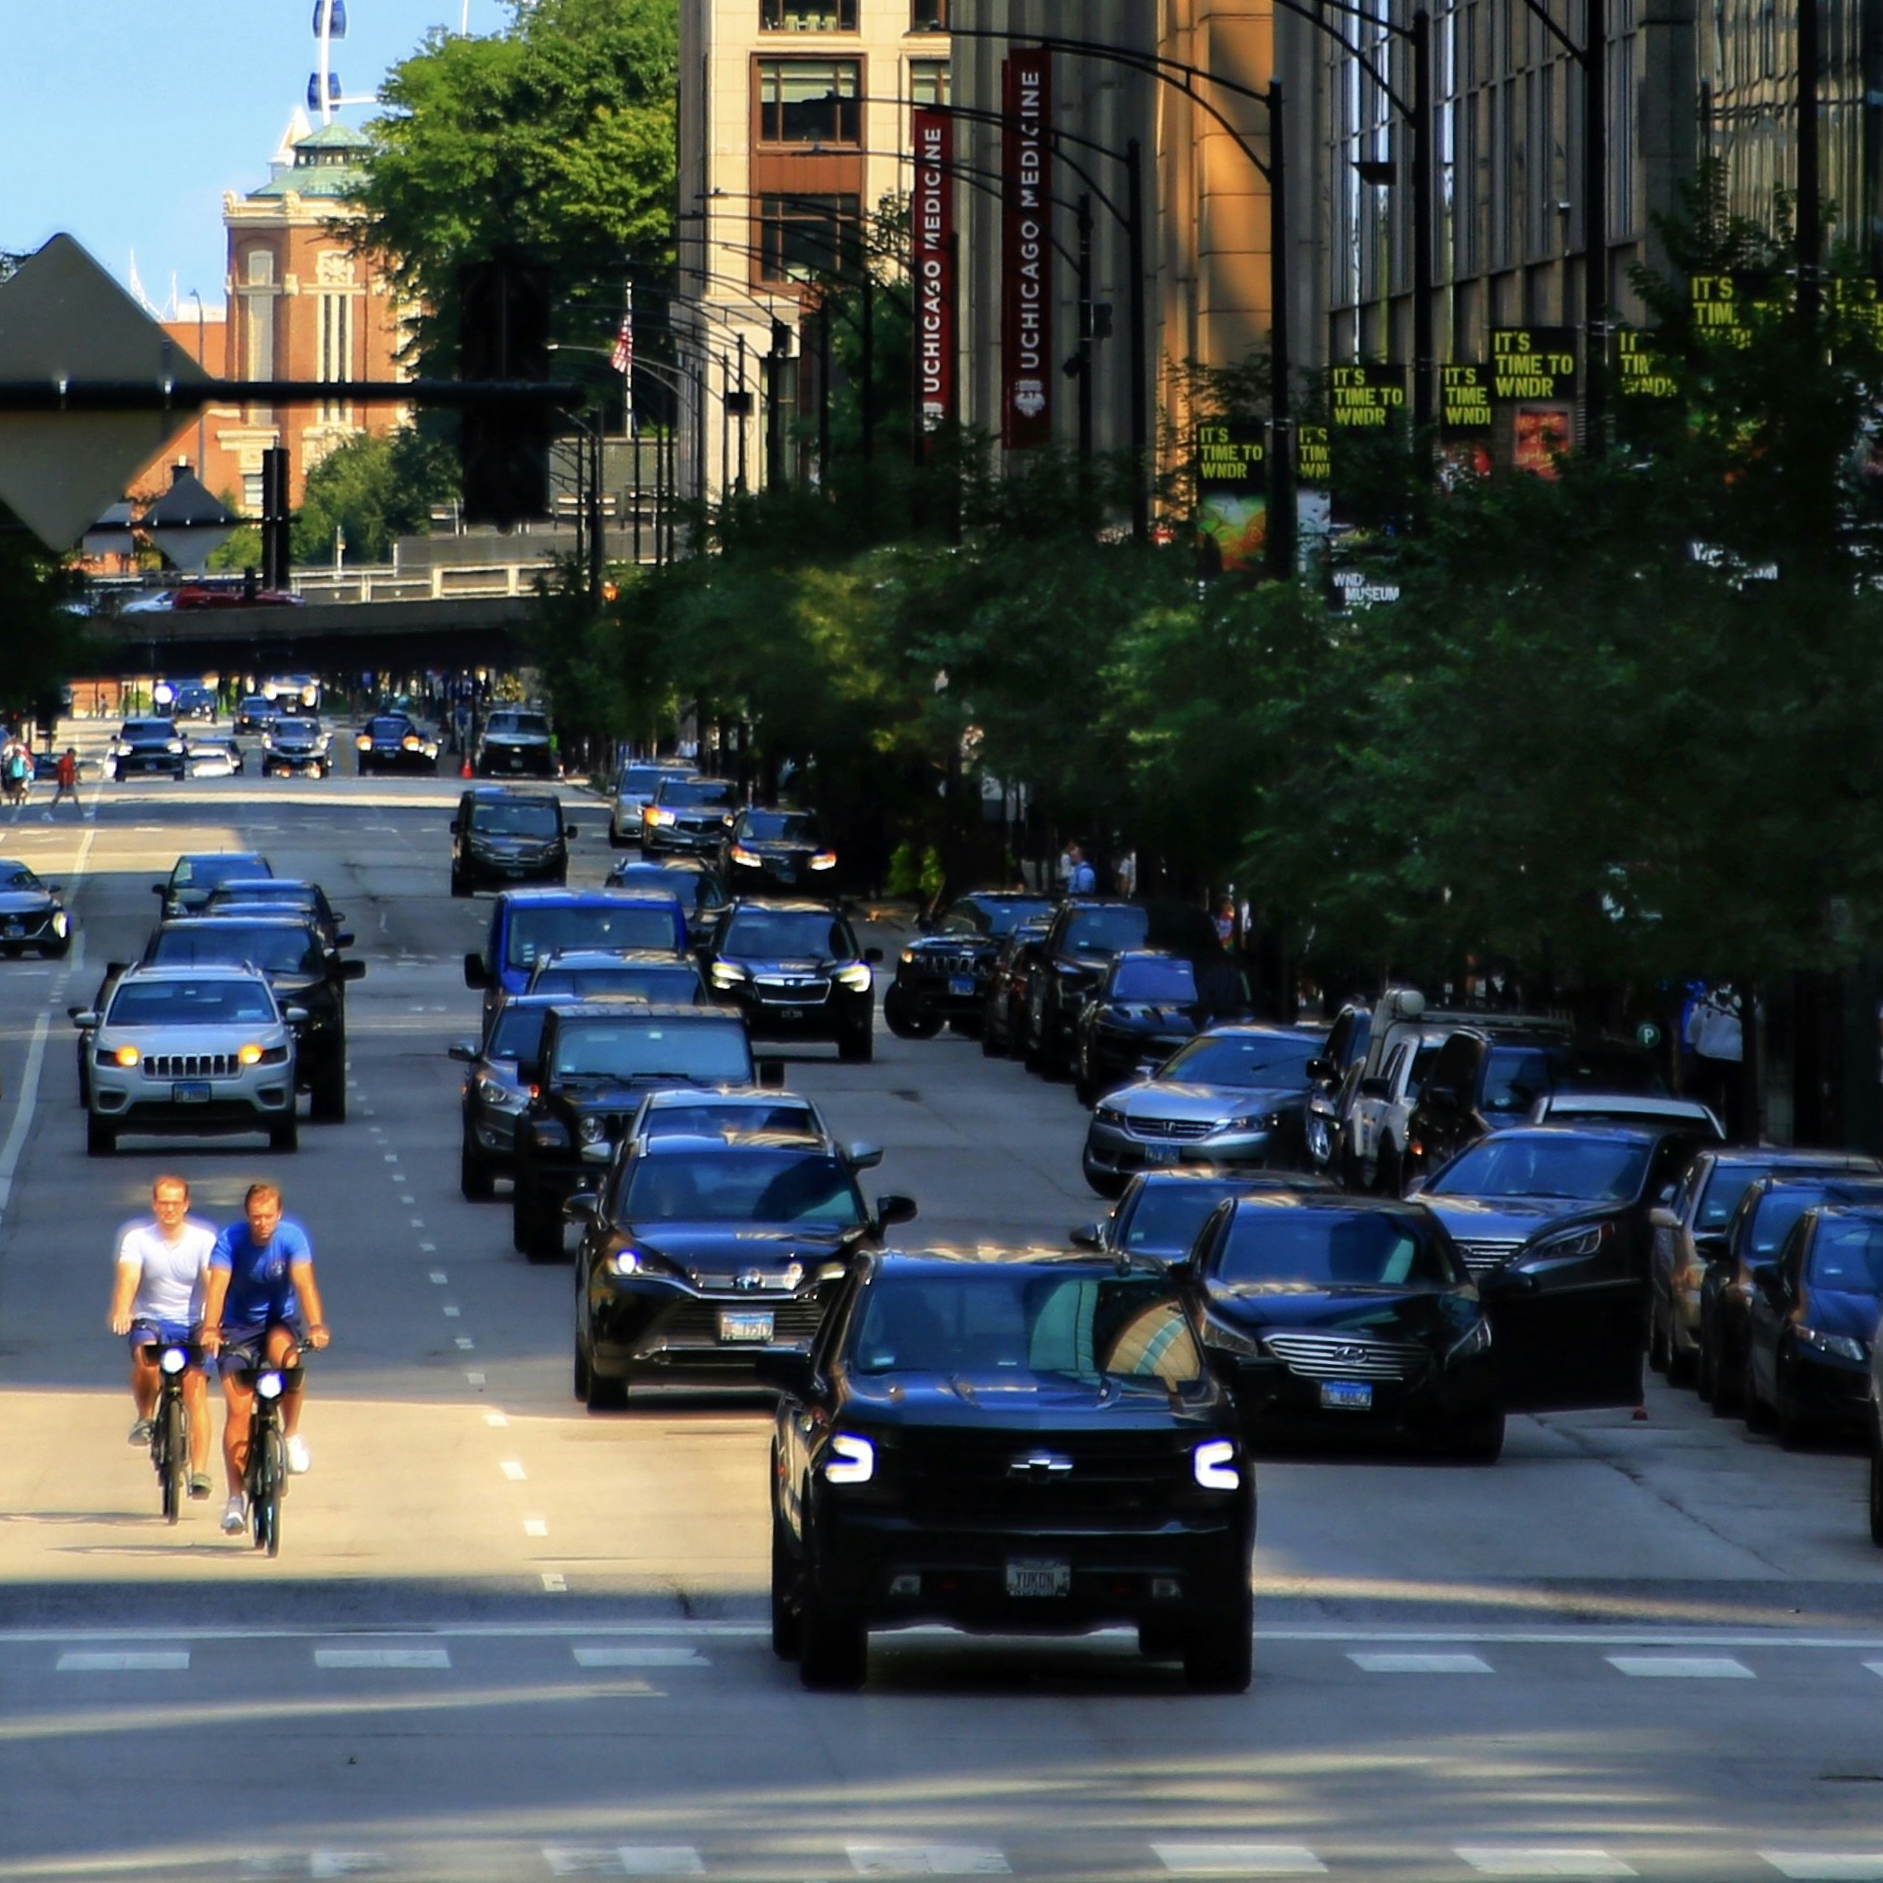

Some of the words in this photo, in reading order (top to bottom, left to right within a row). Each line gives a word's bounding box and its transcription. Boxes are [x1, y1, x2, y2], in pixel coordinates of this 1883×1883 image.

[1021, 220, 1040, 369] UCHICAGO
[923, 260, 942, 393] UCHICAGO
[1494, 332, 1531, 353] IT'S
[1495, 355, 1543, 375] TIME
[1548, 355, 1574, 375] TO
[1334, 387, 1377, 406] TIME
[1380, 387, 1404, 406] TO
[1445, 387, 1488, 405] TIME
[1495, 377, 1555, 397] WNDR
[1334, 407, 1387, 426] WNDR
[1201, 445, 1239, 461] TIME
[1242, 445, 1263, 461] TO
[1202, 462, 1248, 479] WNDR
[1345, 587, 1400, 602] MUSEUM
